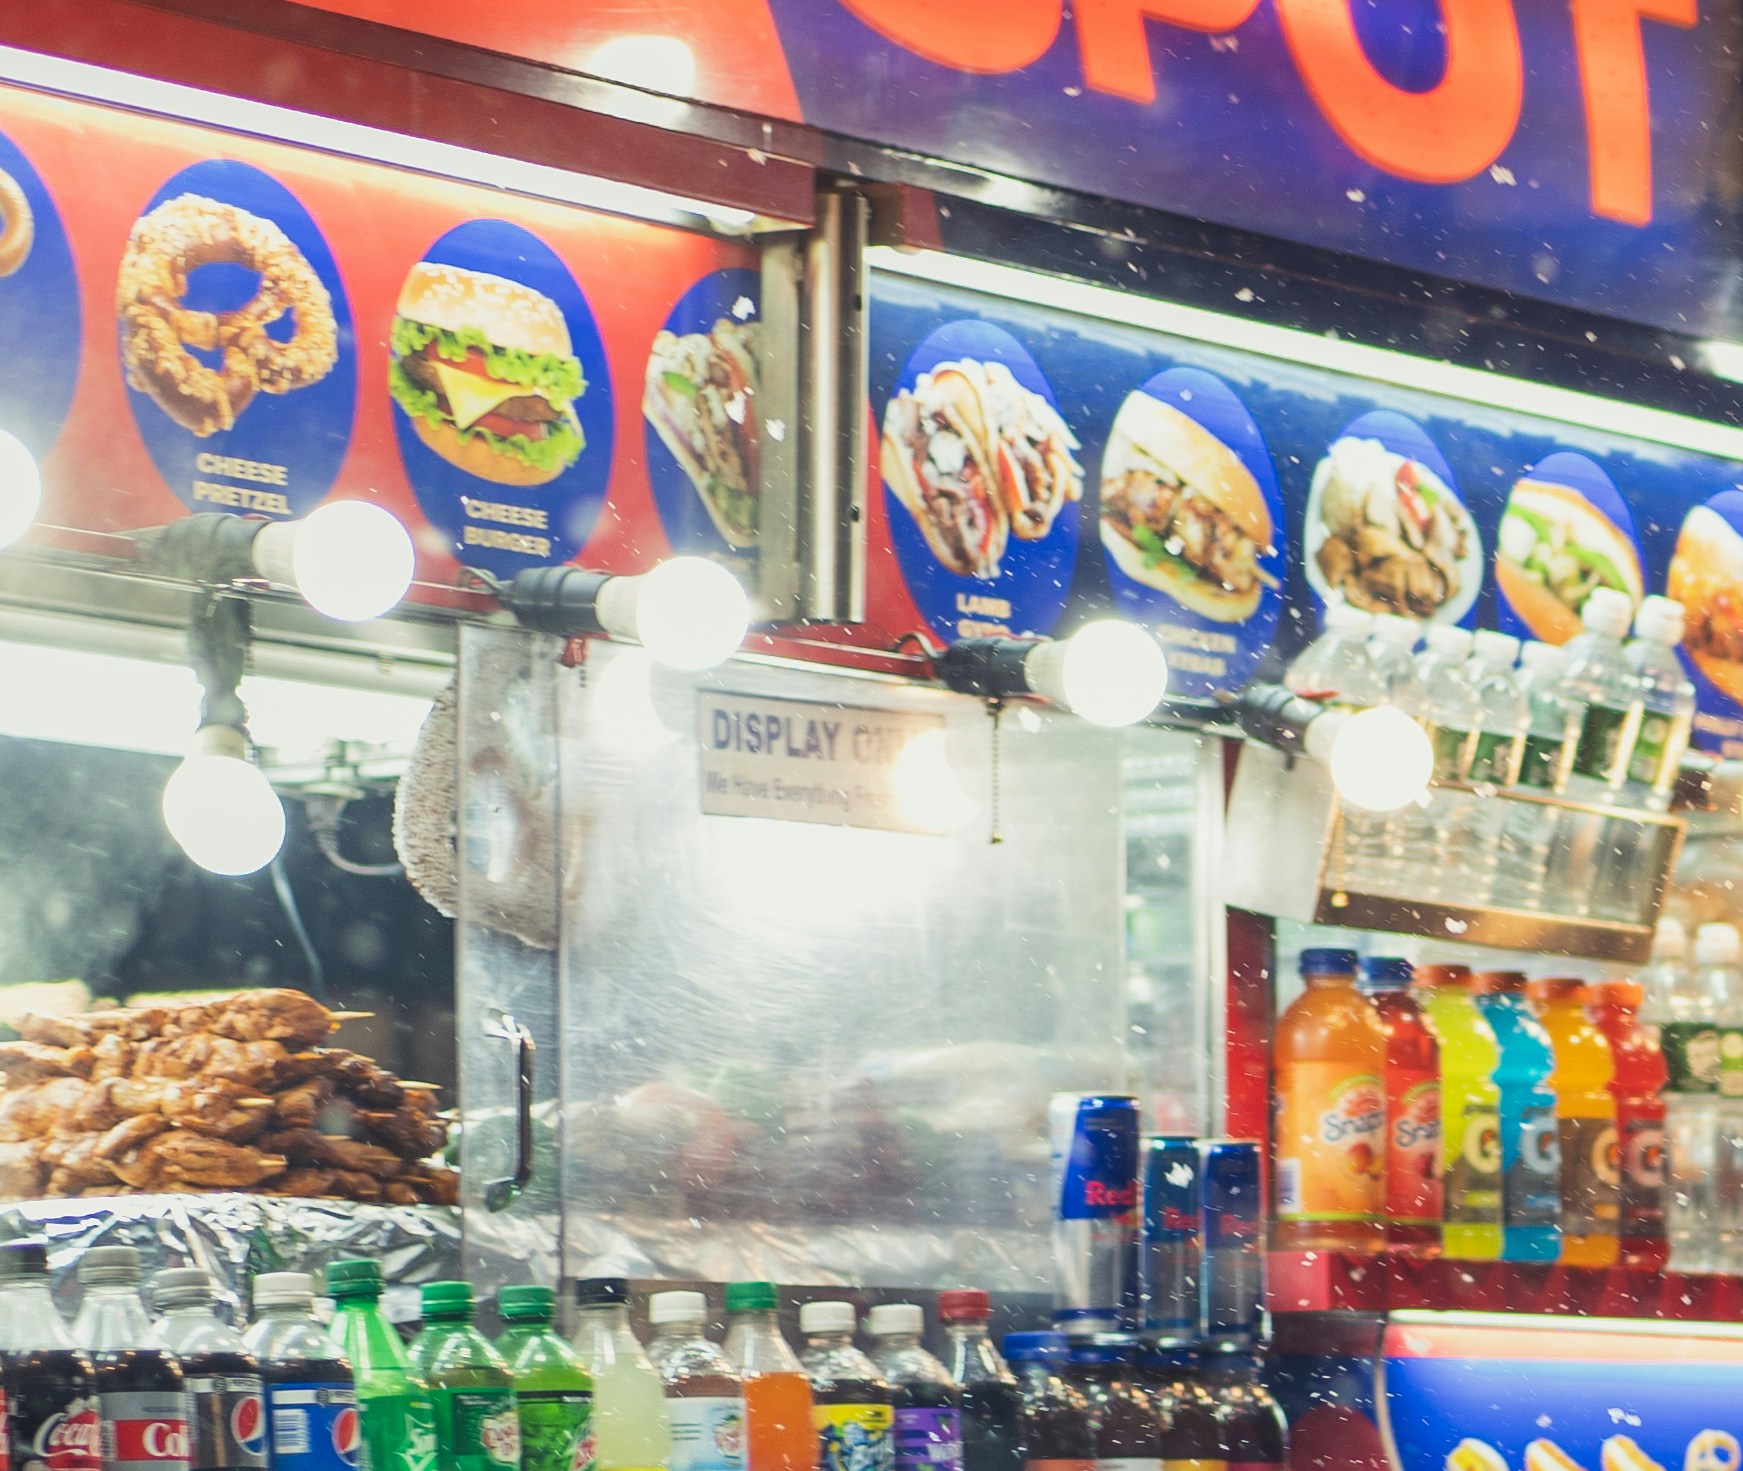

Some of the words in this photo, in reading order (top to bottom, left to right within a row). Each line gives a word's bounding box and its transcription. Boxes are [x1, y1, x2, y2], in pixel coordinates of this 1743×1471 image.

[196, 452, 289, 486] CHEESE
[193, 480, 293, 515] PRETZEL
[465, 499, 549, 530] CHEESE
[463, 526, 551, 556] BURGER
[711, 708, 842, 761] DISPLAY
[772, 777, 850, 812] Everything
